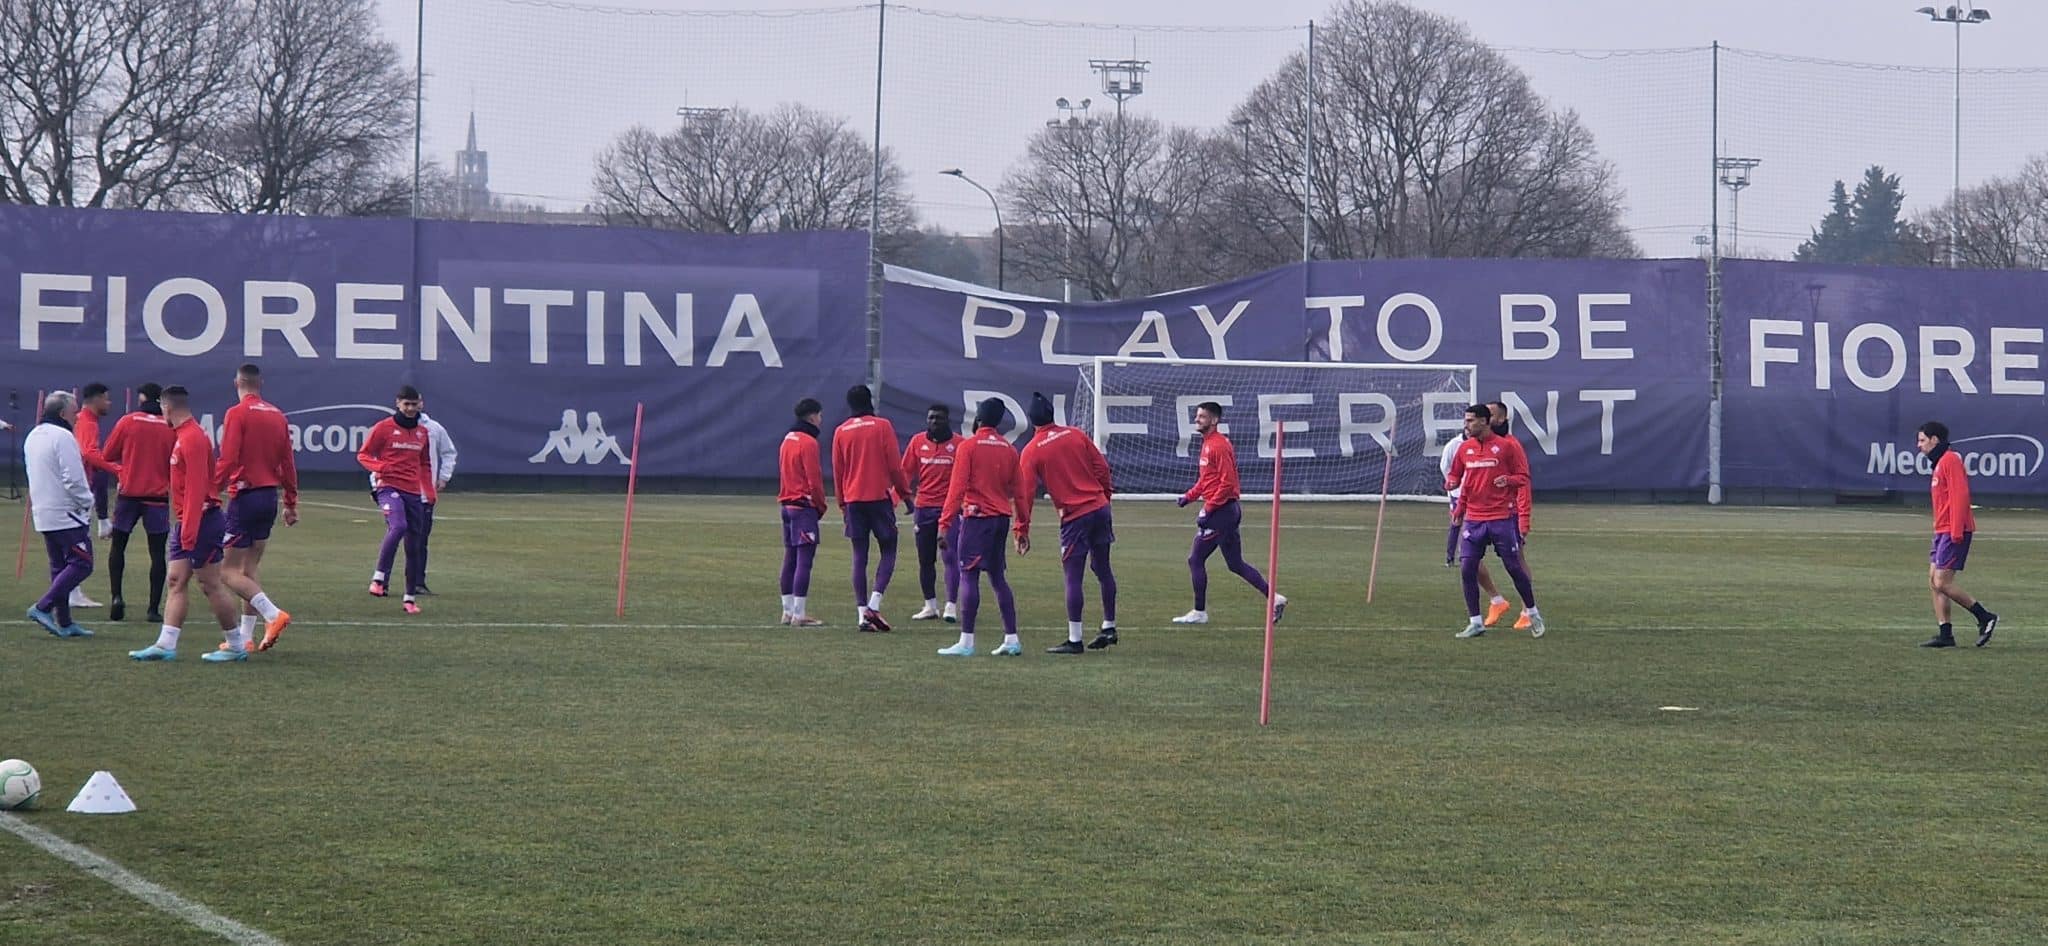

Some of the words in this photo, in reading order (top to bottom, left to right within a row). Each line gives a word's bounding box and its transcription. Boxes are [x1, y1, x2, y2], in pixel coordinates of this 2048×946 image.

[19, 272, 783, 368] FIORENTINA
[961, 295, 1251, 367] PLAY
[1305, 292, 1443, 362] TO
[1500, 293, 1635, 361] BE
[1749, 318, 2045, 396] FIORE
[199, 413, 371, 453] acom
[961, 389, 1637, 458] DIFFERENT
[1867, 442, 2026, 477] Medcom
